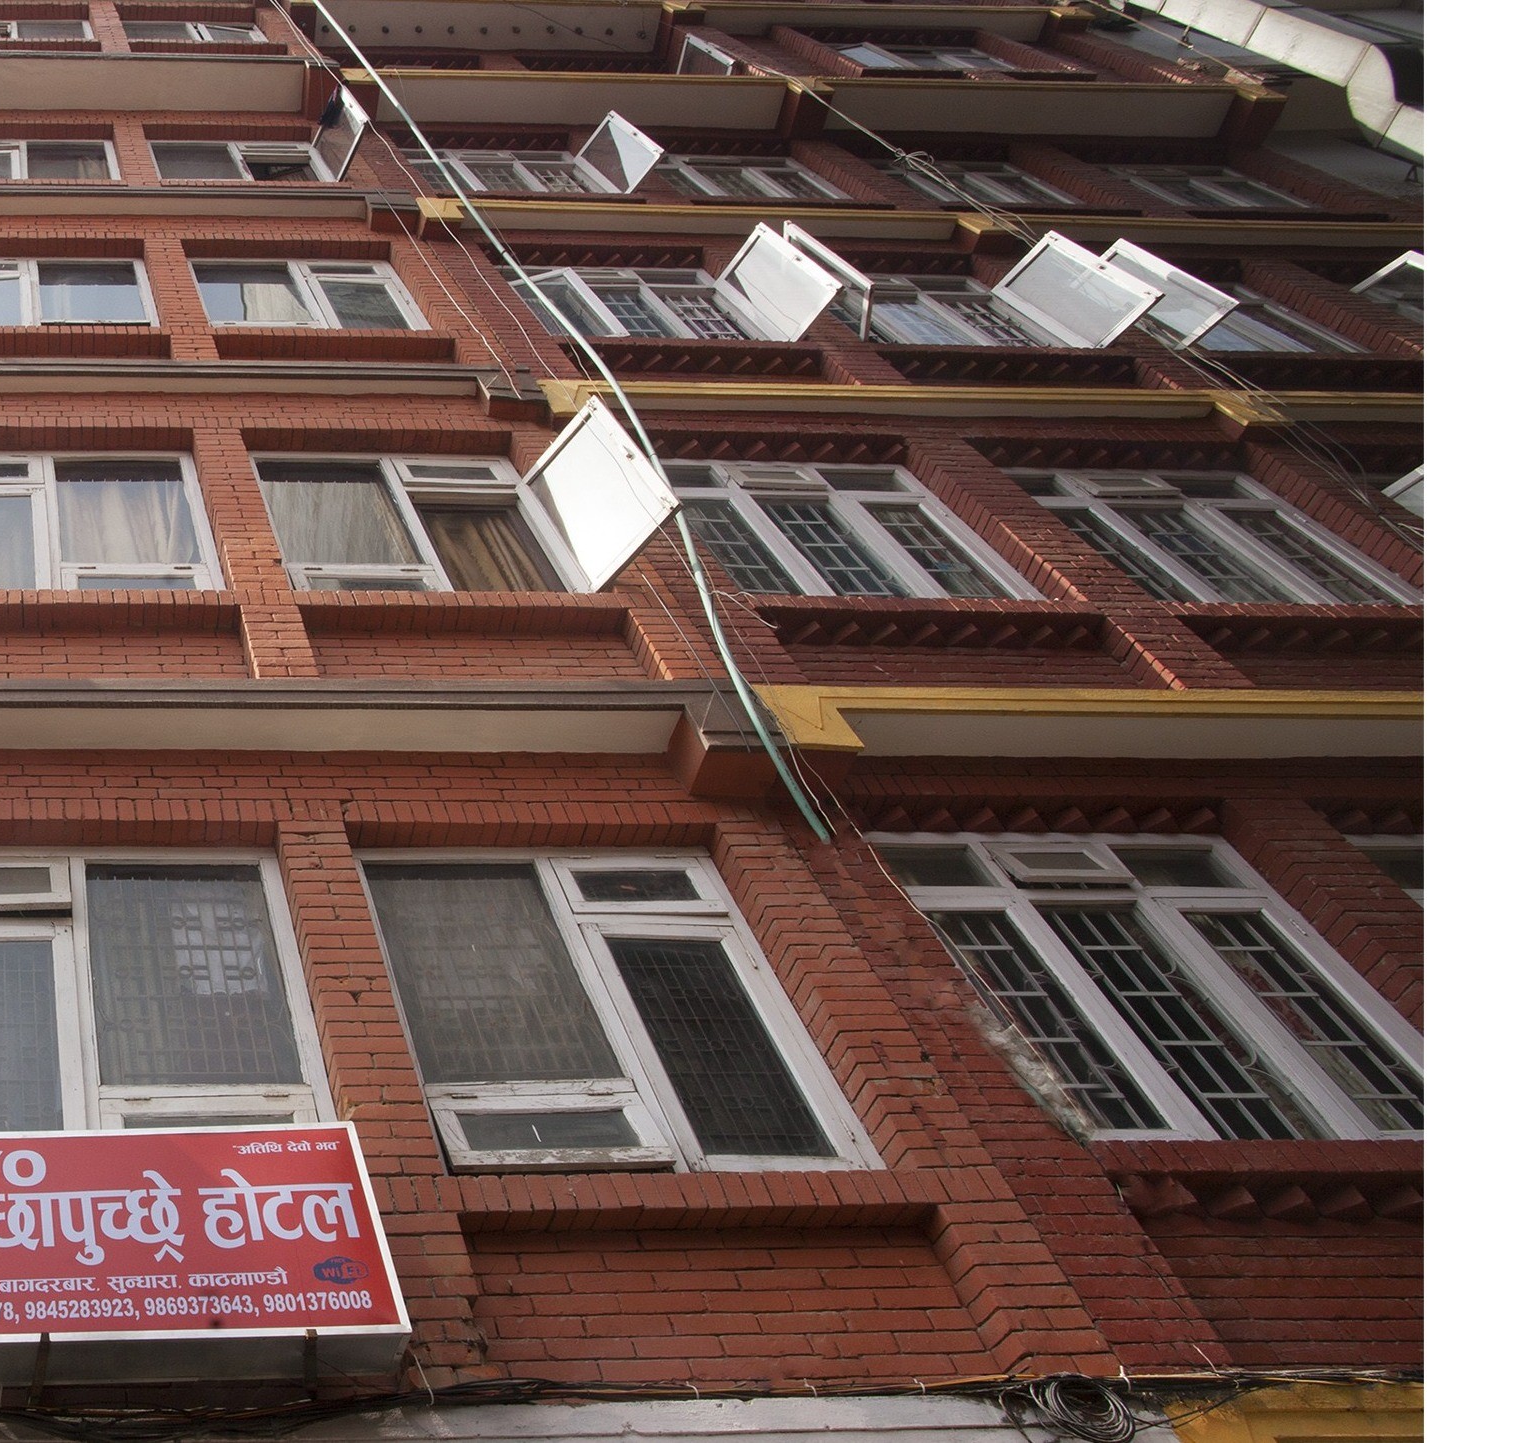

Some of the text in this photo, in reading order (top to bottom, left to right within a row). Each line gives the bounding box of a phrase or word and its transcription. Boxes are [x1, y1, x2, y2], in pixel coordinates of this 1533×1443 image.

[287, 1140, 311, 1153] देवो
[198, 1169, 360, 1250] होटल
[188, 1266, 288, 1288] काठमाण्डौ
[24, 1298, 140, 1320] 9845283923,
[144, 1295, 260, 1317] 9869373643,
[263, 1290, 372, 1313] 9801376008
